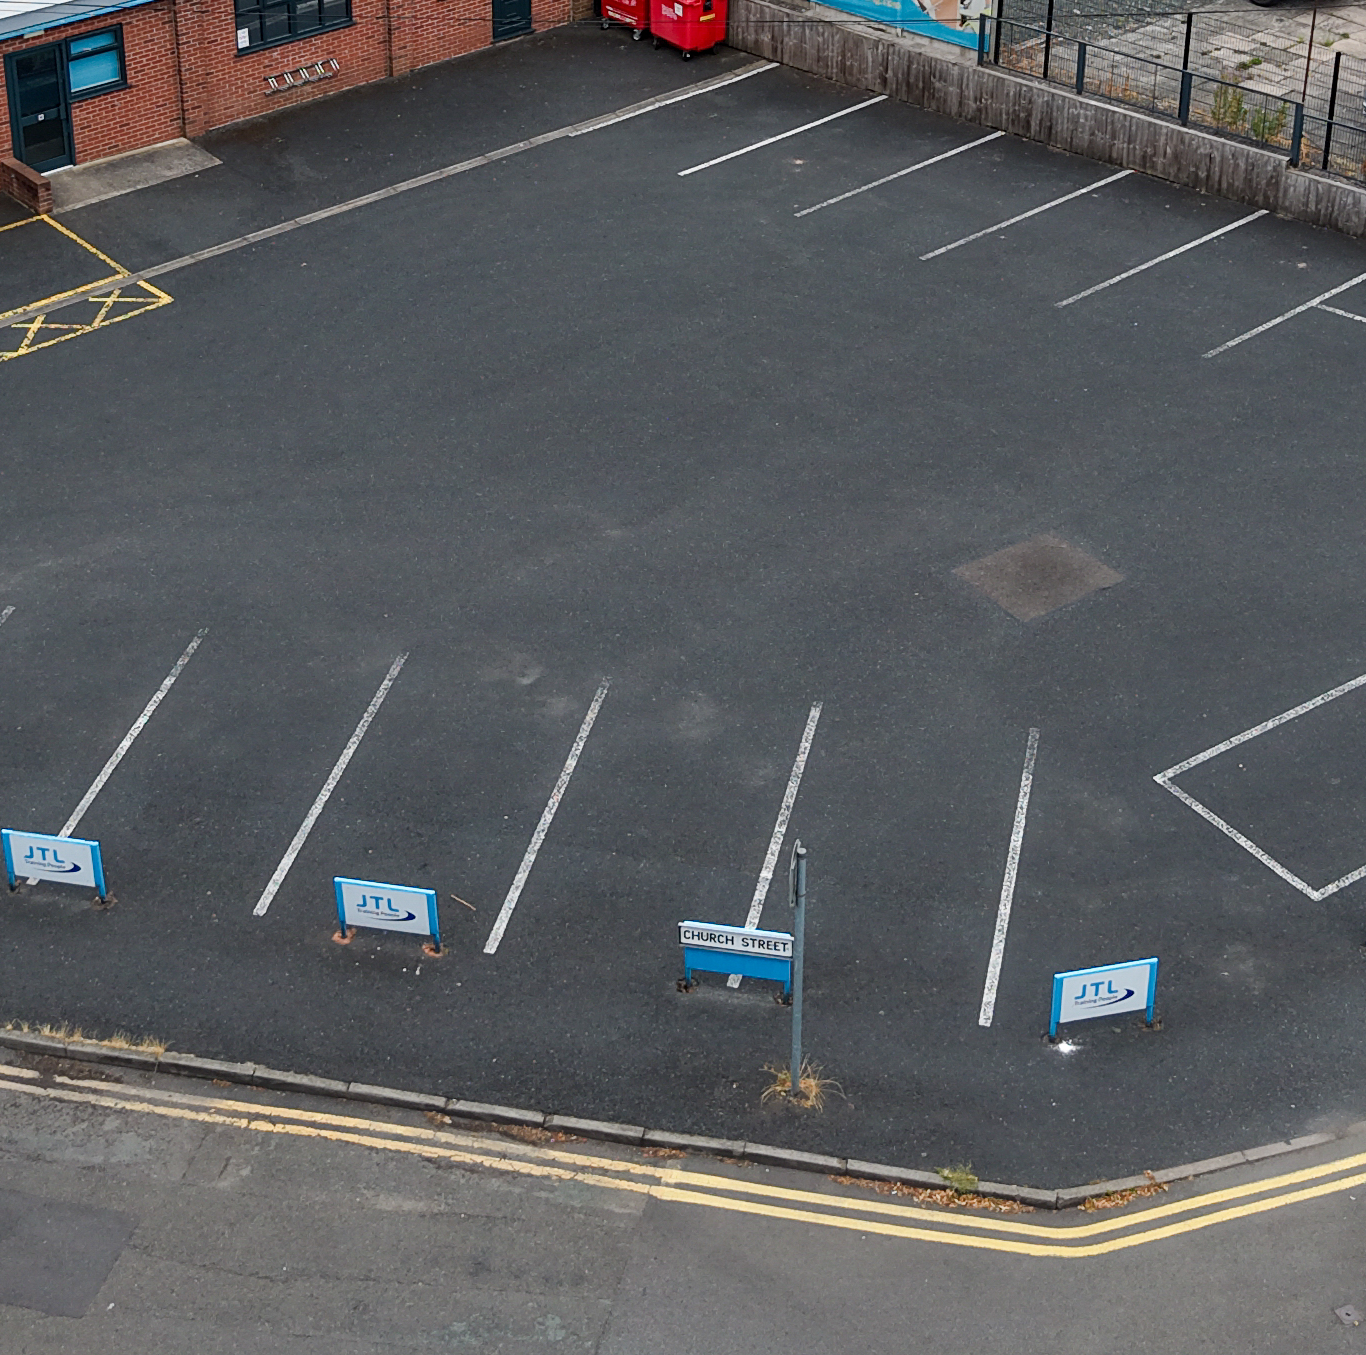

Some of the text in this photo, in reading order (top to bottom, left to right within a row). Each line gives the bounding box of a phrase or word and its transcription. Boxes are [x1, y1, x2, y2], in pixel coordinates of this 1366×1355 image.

[23, 845, 66, 864] JTL
[24, 858, 47, 868] Training
[356, 894, 400, 913] JTL
[683, 929, 789, 953] CHURCH STREET
[1073, 979, 1119, 1000] JTL
